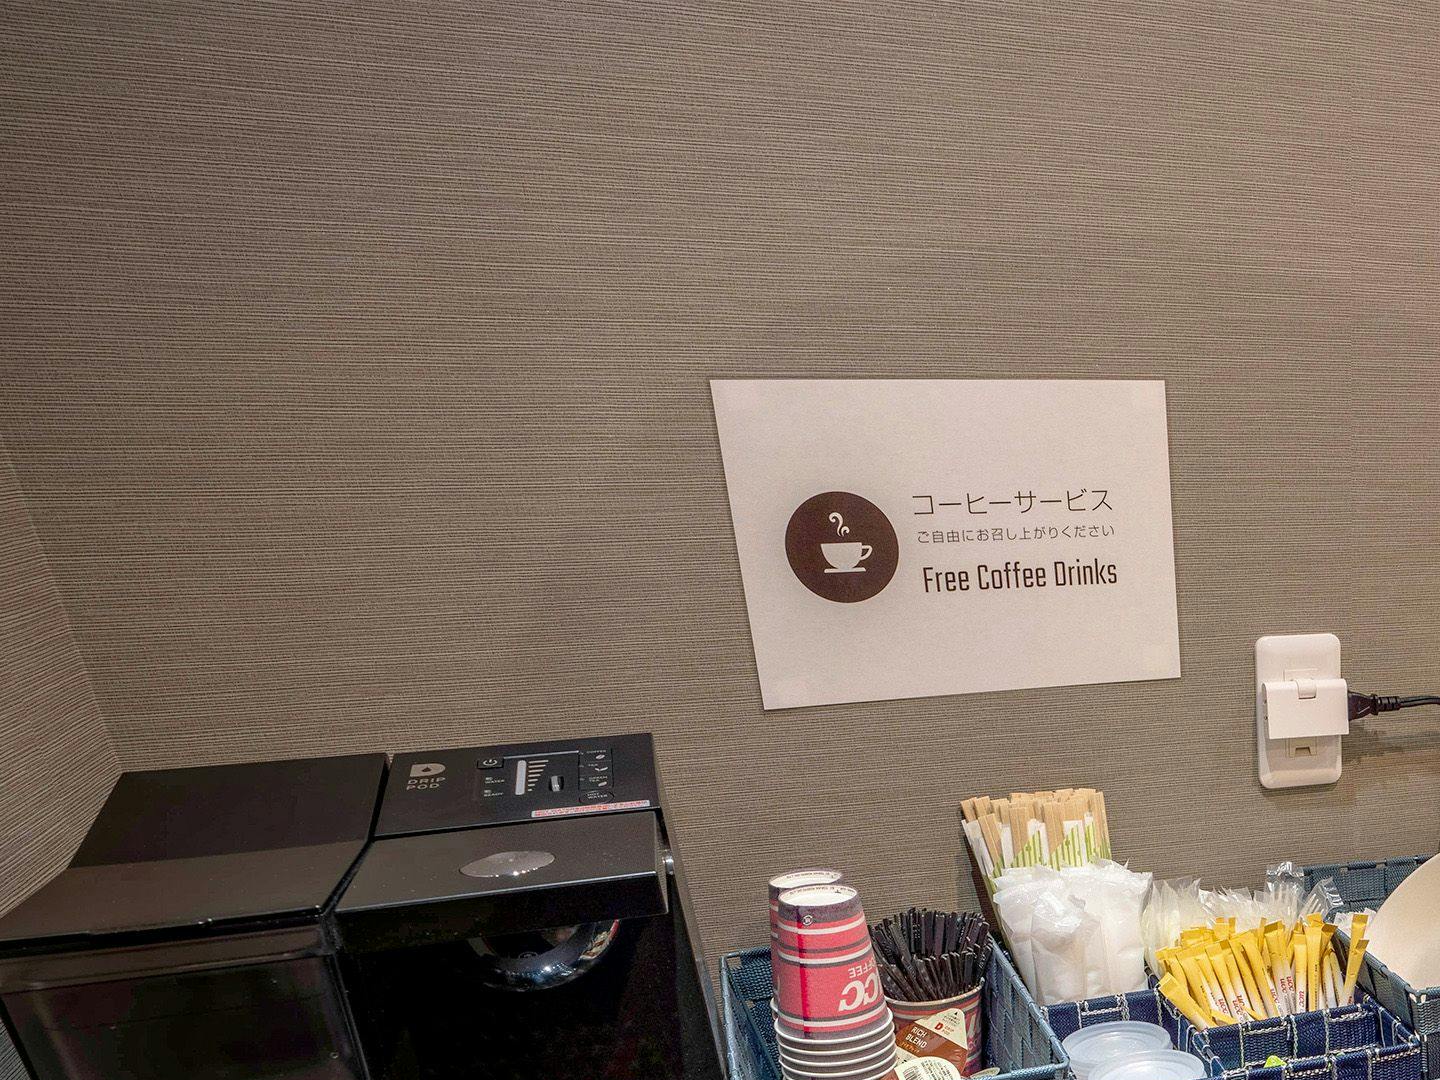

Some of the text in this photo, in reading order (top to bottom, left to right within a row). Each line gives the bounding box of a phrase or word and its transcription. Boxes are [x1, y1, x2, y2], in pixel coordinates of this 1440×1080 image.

[912, 489, 1113, 516] コーヒーサービス
[917, 524, 1115, 544] ご自由にお召し上がりください
[923, 557, 1118, 593] Free Coffee Drinks
[406, 783, 440, 791] POD
[407, 776, 446, 785] DRIP
[838, 972, 880, 1011] CC
[911, 1026, 928, 1038] RICH
[905, 1034, 928, 1049] BLEND
